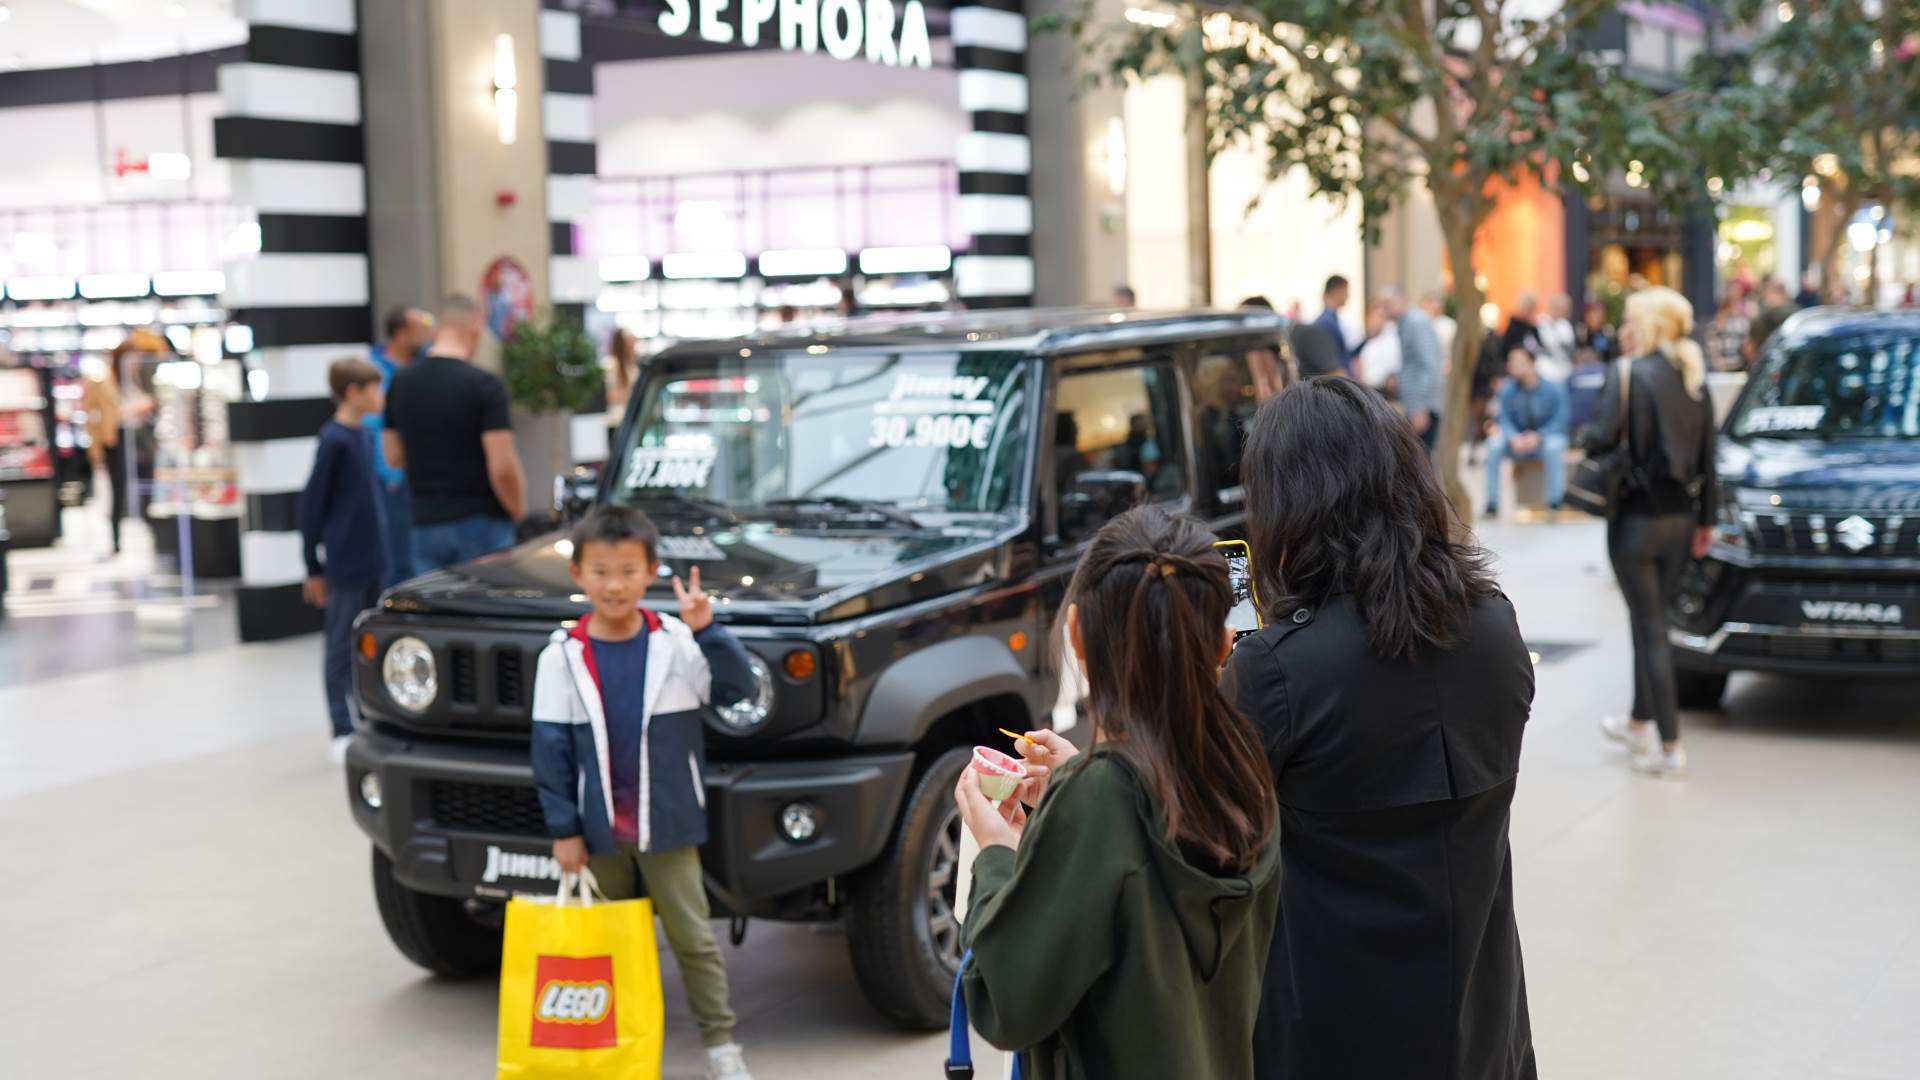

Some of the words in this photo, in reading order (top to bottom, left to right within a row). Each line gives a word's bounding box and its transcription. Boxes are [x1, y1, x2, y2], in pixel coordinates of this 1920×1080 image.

[657, 0, 932, 69] SEPHORA
[868, 415, 991, 449] 30.900€
[1801, 600, 1902, 623] VITARA
[540, 984, 608, 1019] LEGO
